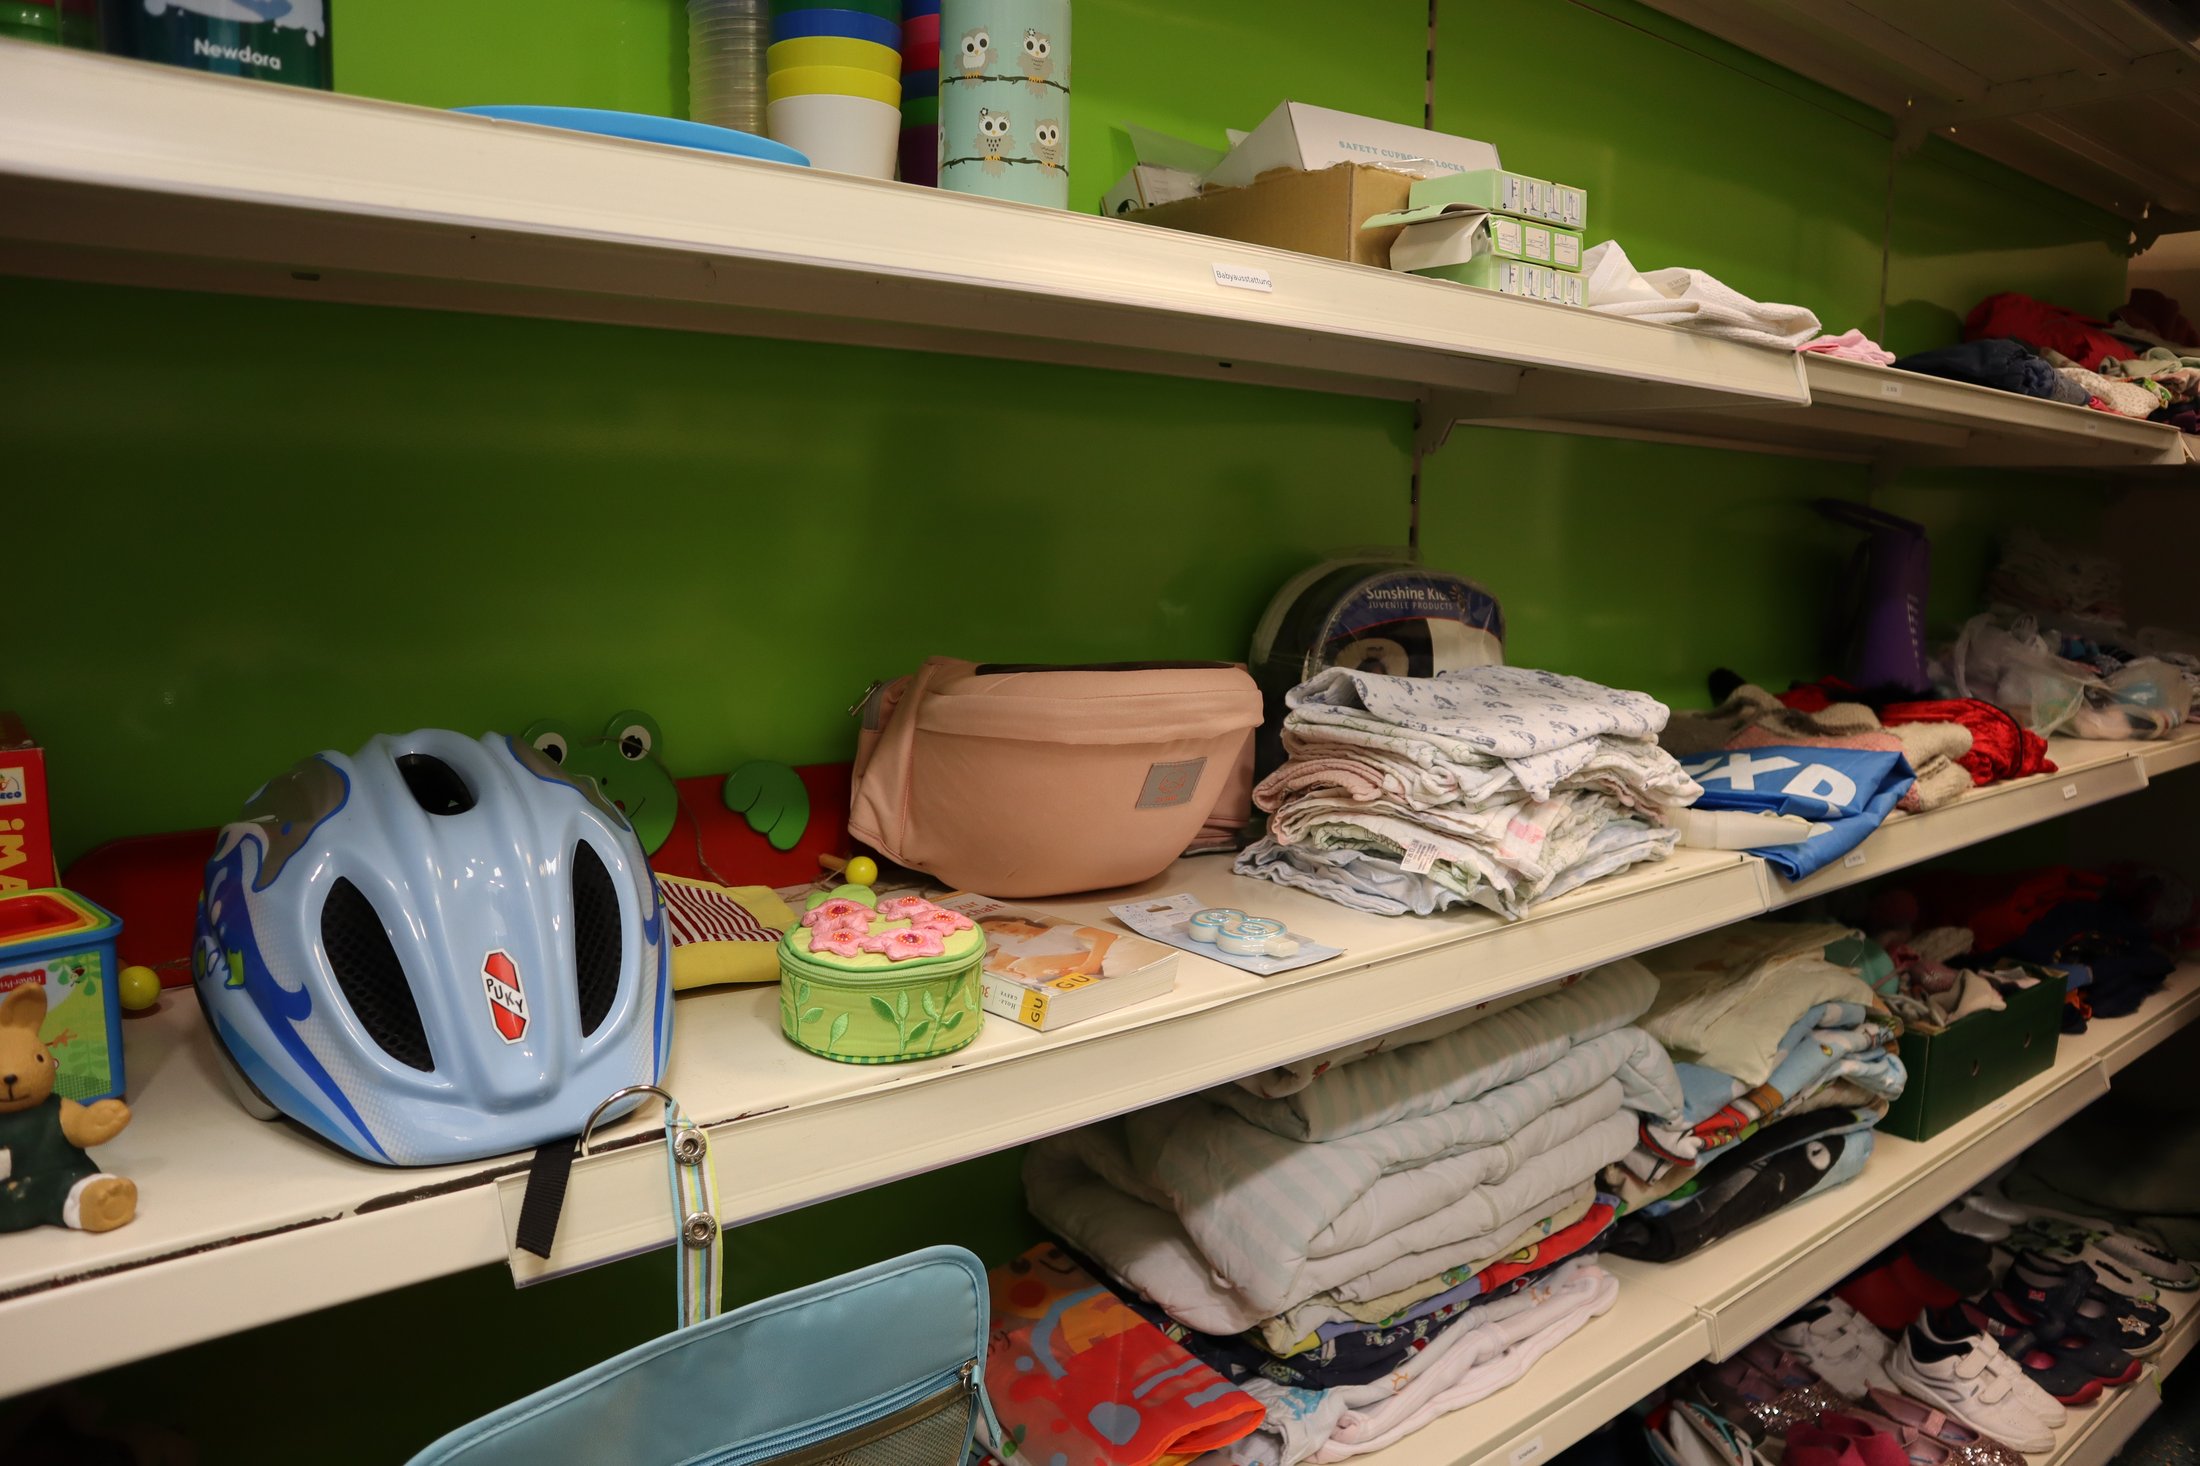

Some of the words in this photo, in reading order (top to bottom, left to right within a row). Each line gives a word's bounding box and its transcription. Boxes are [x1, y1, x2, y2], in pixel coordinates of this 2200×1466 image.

[193, 37, 281, 70] Newdora
[1339, 140, 1378, 155] SAFETY
[1381, 149, 1435, 167] CUPBO
[1435, 161, 1465, 172] LOCKS
[1216, 270, 1273, 288] Babyausstattung
[1366, 586, 1425, 601] Sunshine
[1412, 602, 1453, 611] PRODUCTS
[0, 818, 28, 893] iMA
[958, 901, 979, 910] zur
[1055, 975, 1091, 990] GU
[486, 978, 523, 1013] PUKY
[1030, 998, 1044, 1023] GU
